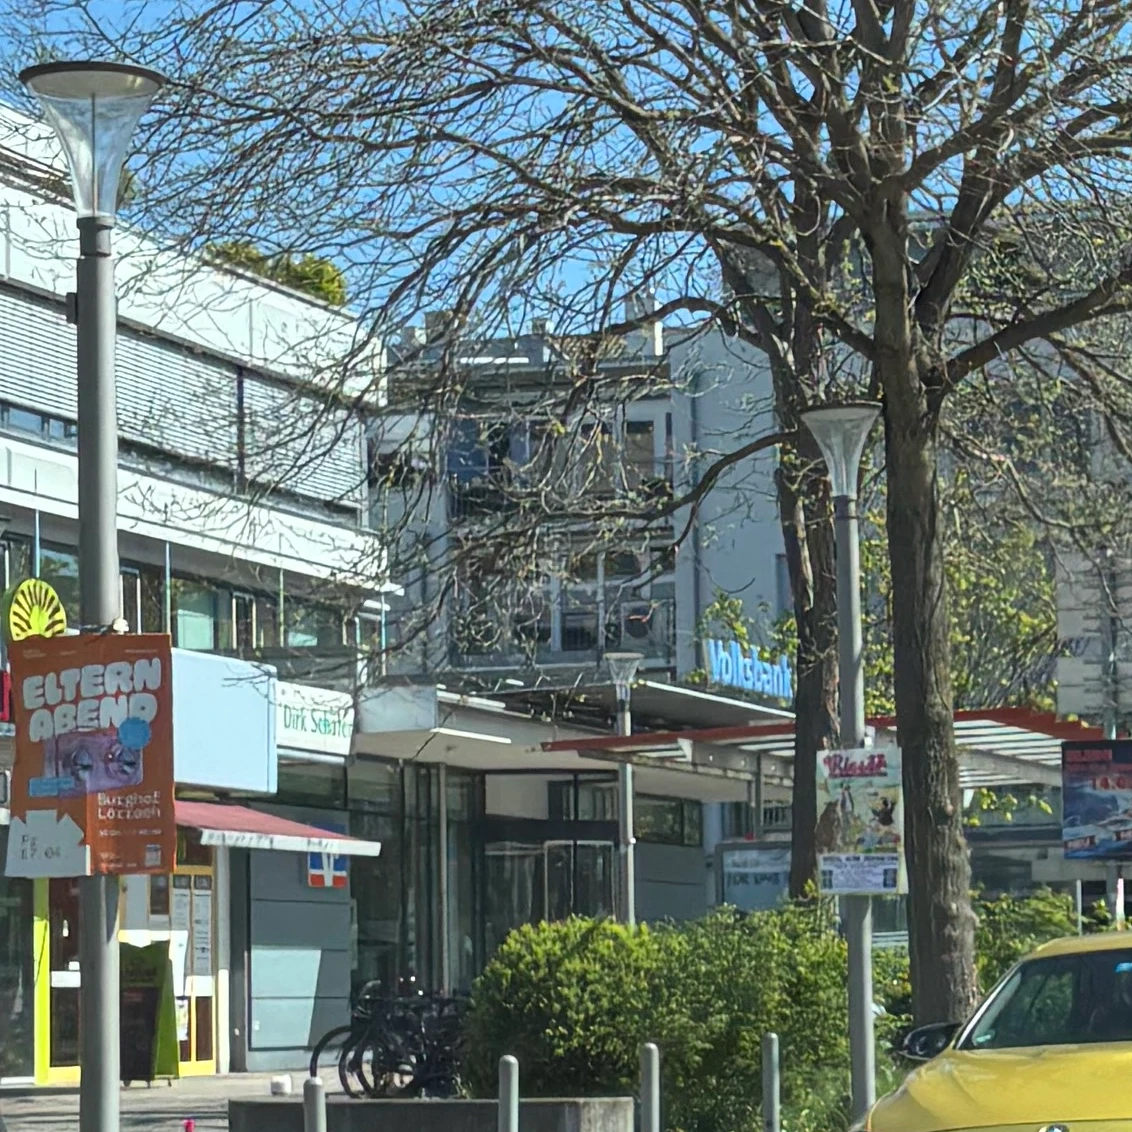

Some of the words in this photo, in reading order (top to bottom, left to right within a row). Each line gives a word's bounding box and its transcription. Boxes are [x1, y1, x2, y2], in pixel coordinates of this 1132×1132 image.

[23, 657, 161, 709] ELTERN
[708, 638, 793, 699] Volksbank
[29, 693, 157, 742] ABEND
[284, 704, 307, 732] Dirk
[97, 791, 160, 807] Burghof
